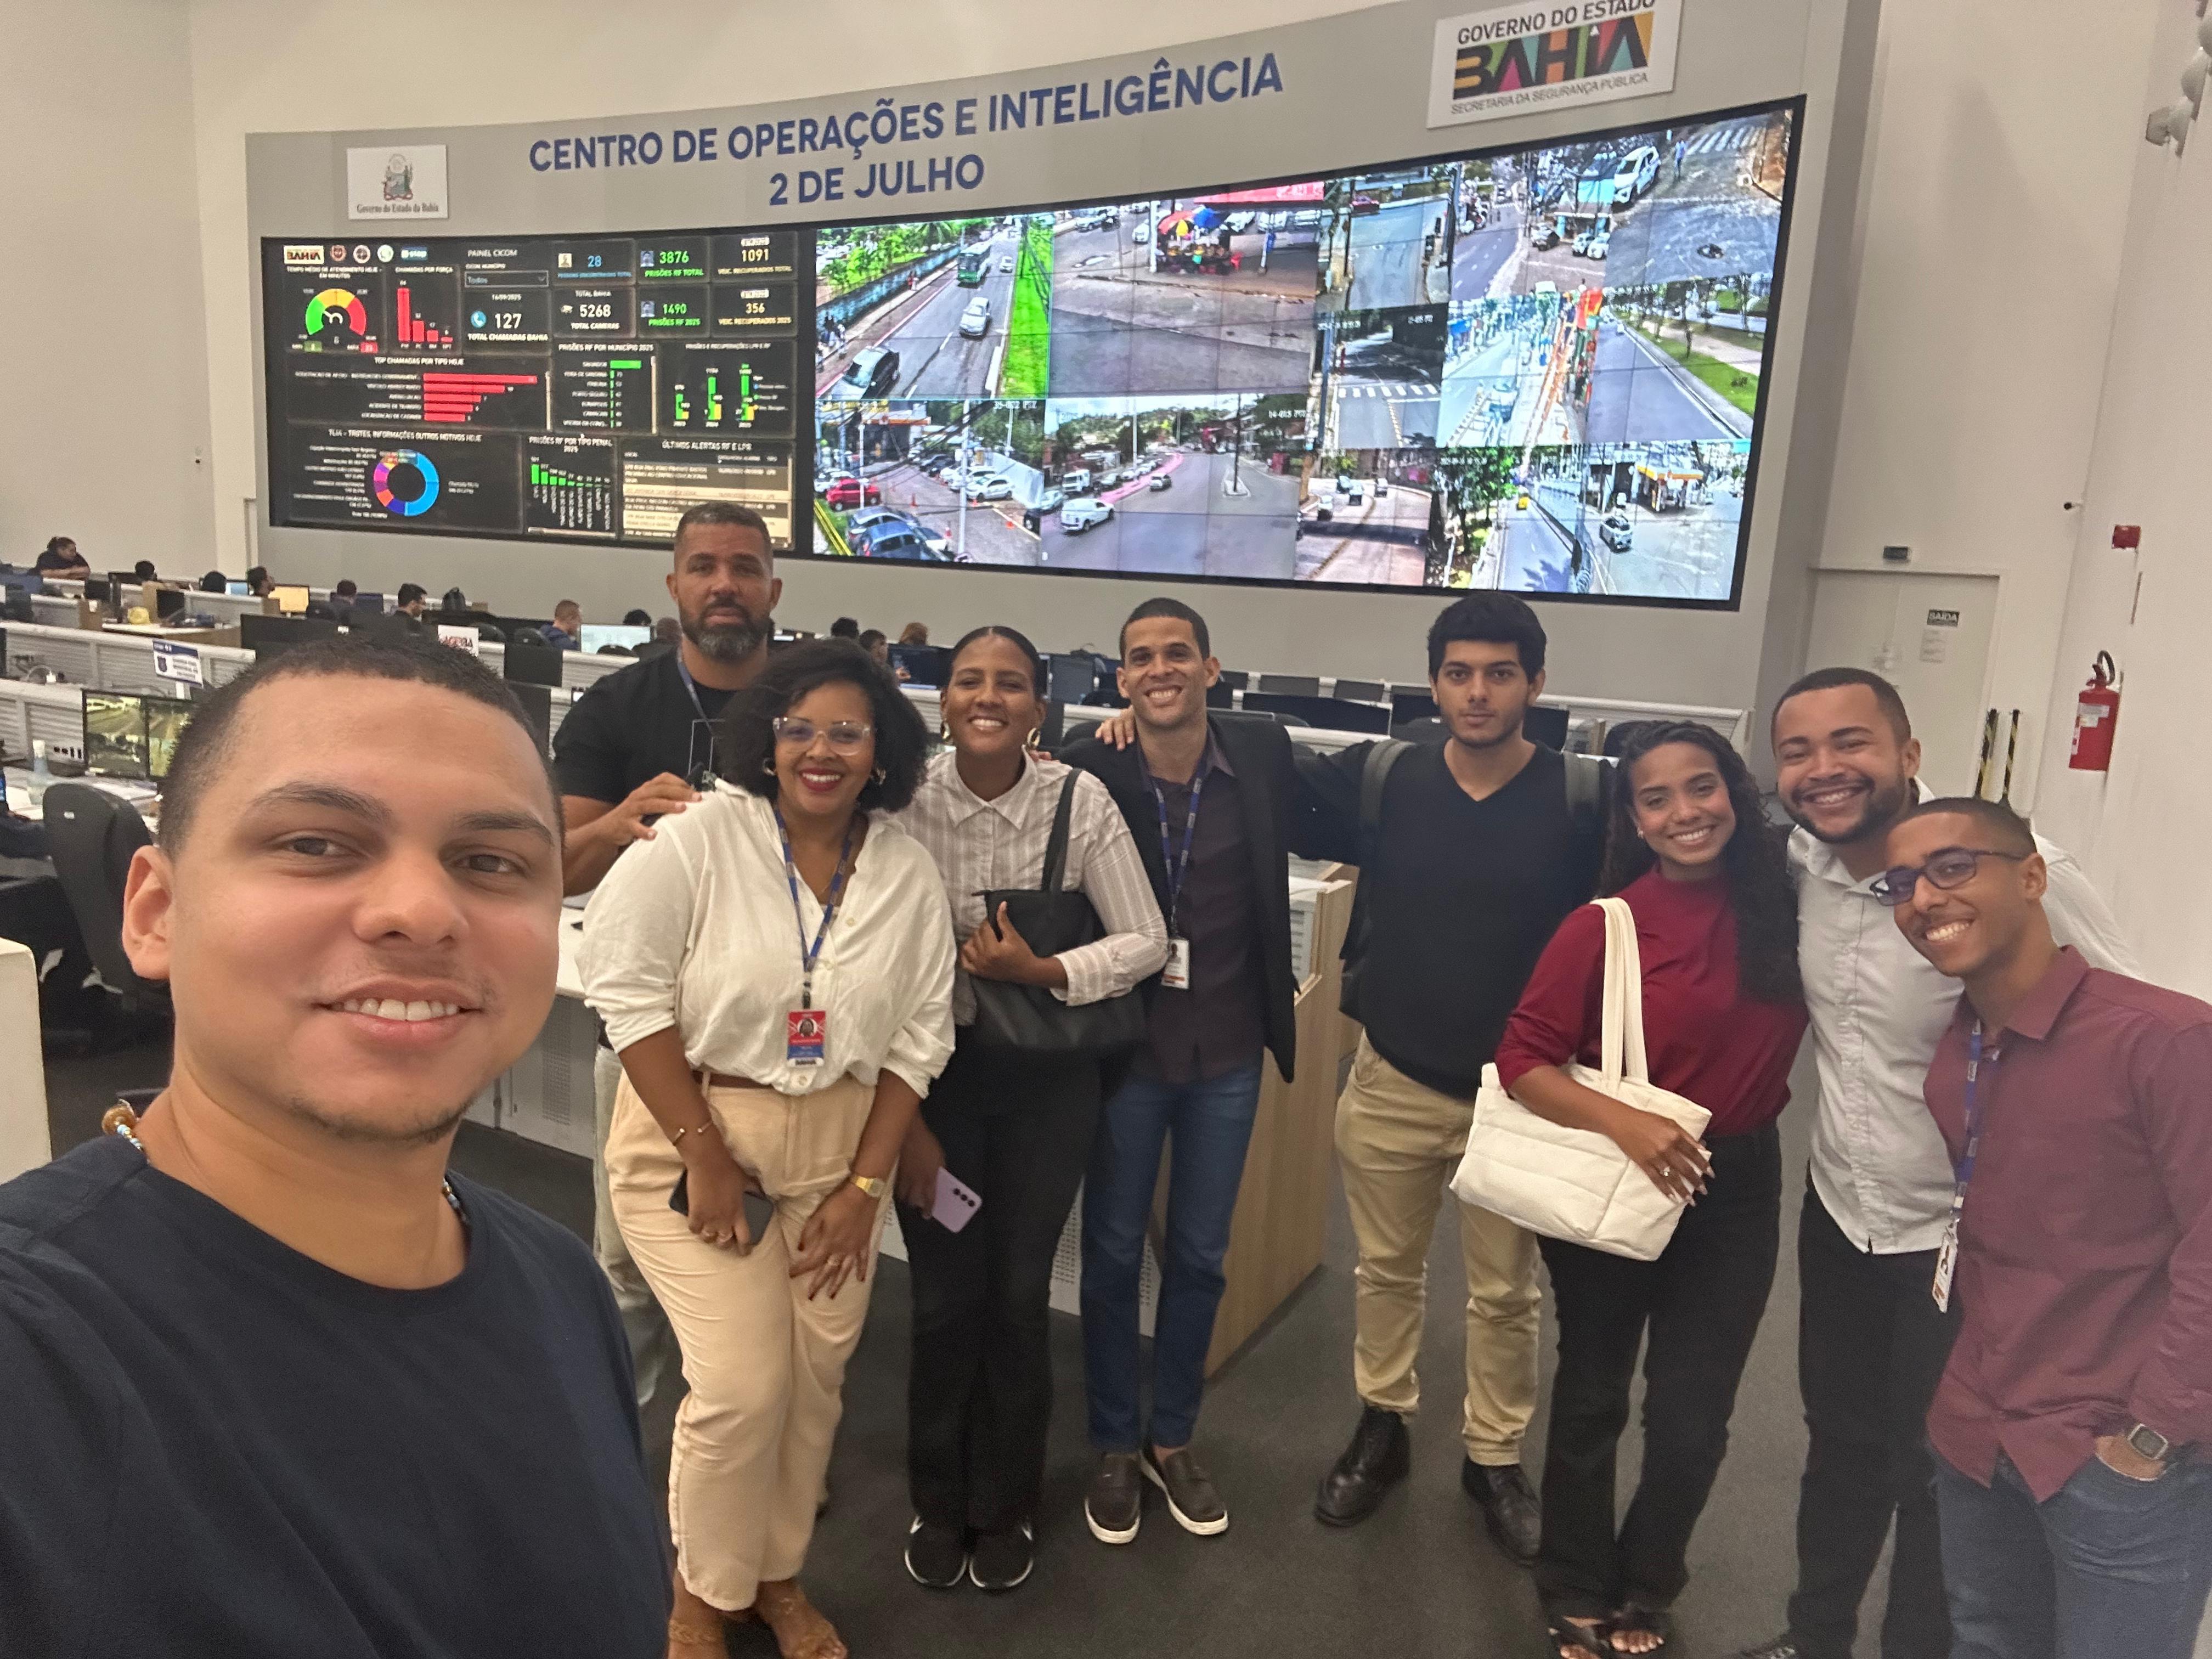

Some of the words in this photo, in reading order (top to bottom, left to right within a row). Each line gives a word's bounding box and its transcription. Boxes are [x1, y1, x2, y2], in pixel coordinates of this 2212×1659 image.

[1458, 12, 1545, 45] GOVERNO
[1551, 7, 1578, 29] DO
[1453, 16, 1648, 99] BAHIA
[1451, 94, 1513, 114] SECRETARIA
[1516, 93, 1530, 104] DA
[1532, 81, 1599, 101] SEGURANÇA
[529, 132, 662, 172] CENTRO
[673, 128, 717, 162] DE
[728, 98, 945, 160] OPERAÇÕES
[955, 98, 977, 136] E
[989, 53, 1283, 132] INTELIGÊNCIA
[769, 172, 788, 206] 2
[798, 167, 844, 204] DE
[854, 154, 985, 199] JULHO
[588, 255, 602, 268] 28
[659, 251, 689, 264] 3876
[741, 249, 769, 262] 1091
[580, 304, 611, 317] 5268
[663, 303, 687, 314] 1490
[746, 303, 765, 314] 356
[495, 313, 521, 329] 127
